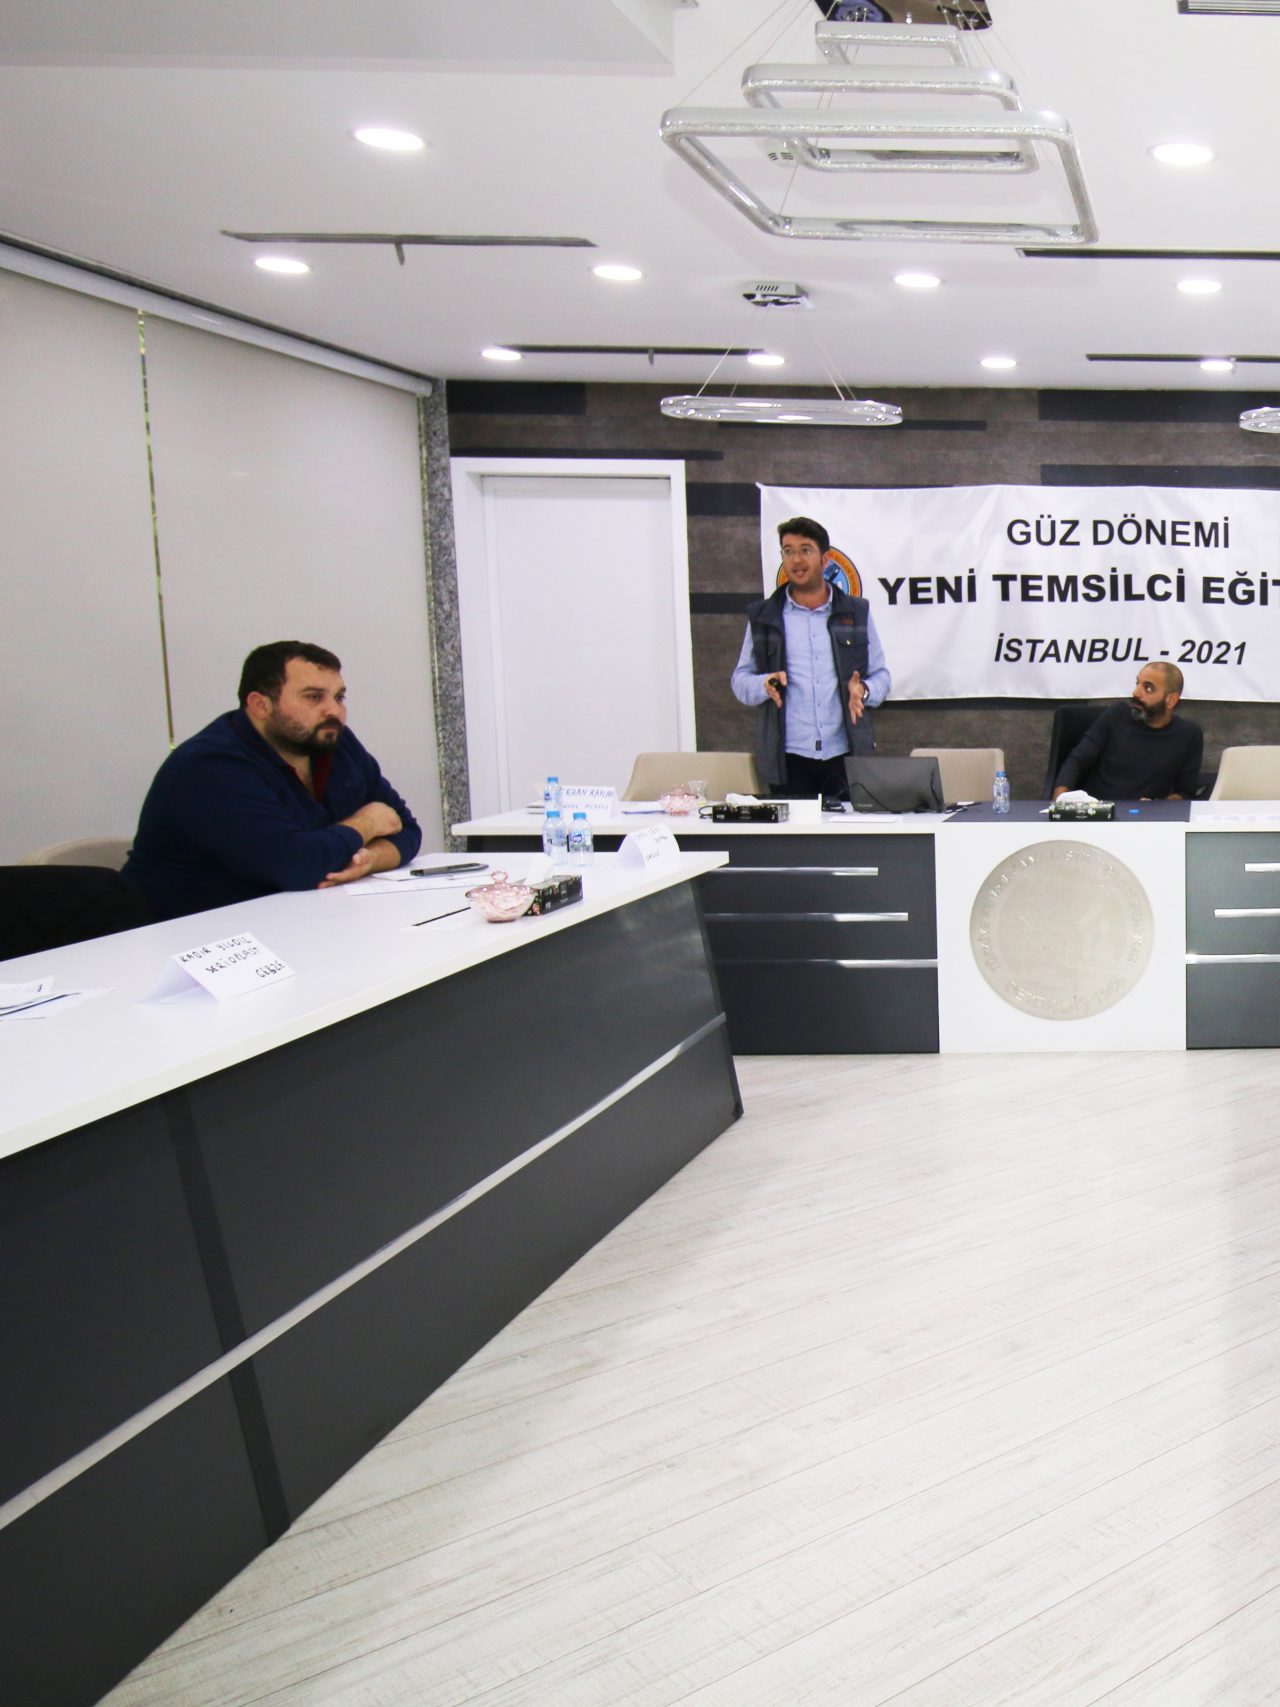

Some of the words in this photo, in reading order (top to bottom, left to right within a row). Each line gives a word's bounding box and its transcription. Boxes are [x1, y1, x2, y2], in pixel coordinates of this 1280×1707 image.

[1007, 514, 1080, 546] GÜZ
[1092, 513, 1229, 548] DÖNEMİ
[877, 568, 977, 605] YENİ
[992, 567, 1186, 603] TEMSİLCİ
[994, 633, 1149, 663] İSTANBUL
[1178, 639, 1247, 665] 2021
